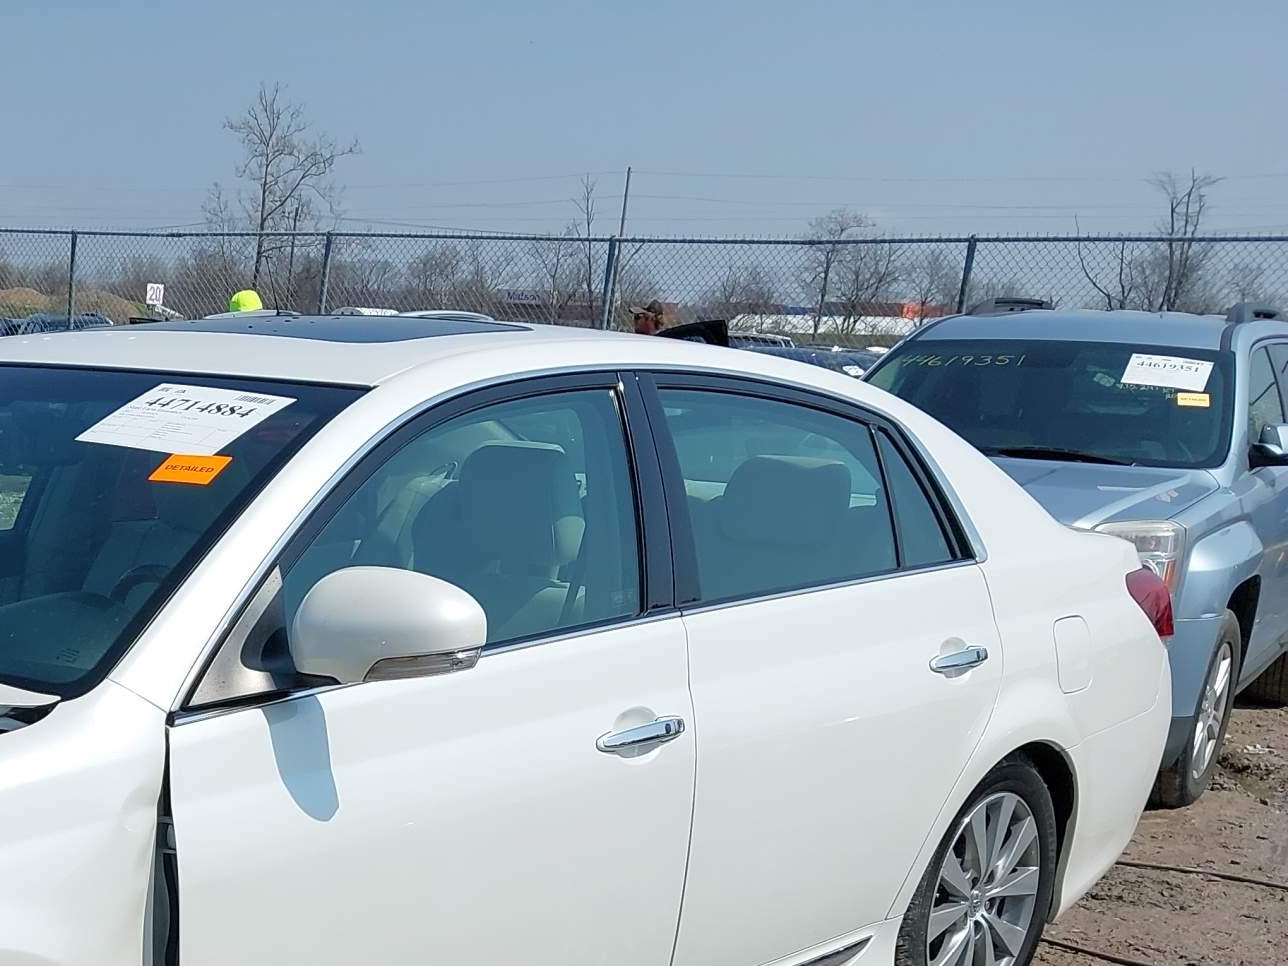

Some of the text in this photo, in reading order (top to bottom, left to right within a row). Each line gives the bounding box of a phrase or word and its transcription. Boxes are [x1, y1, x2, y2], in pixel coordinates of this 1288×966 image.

[149, 286, 162, 302] 20
[902, 353, 1027, 368] 44619351
[1136, 359, 1200, 373] 44619351
[145, 396, 259, 419] 44714884
[164, 463, 215, 474] DETAILED
